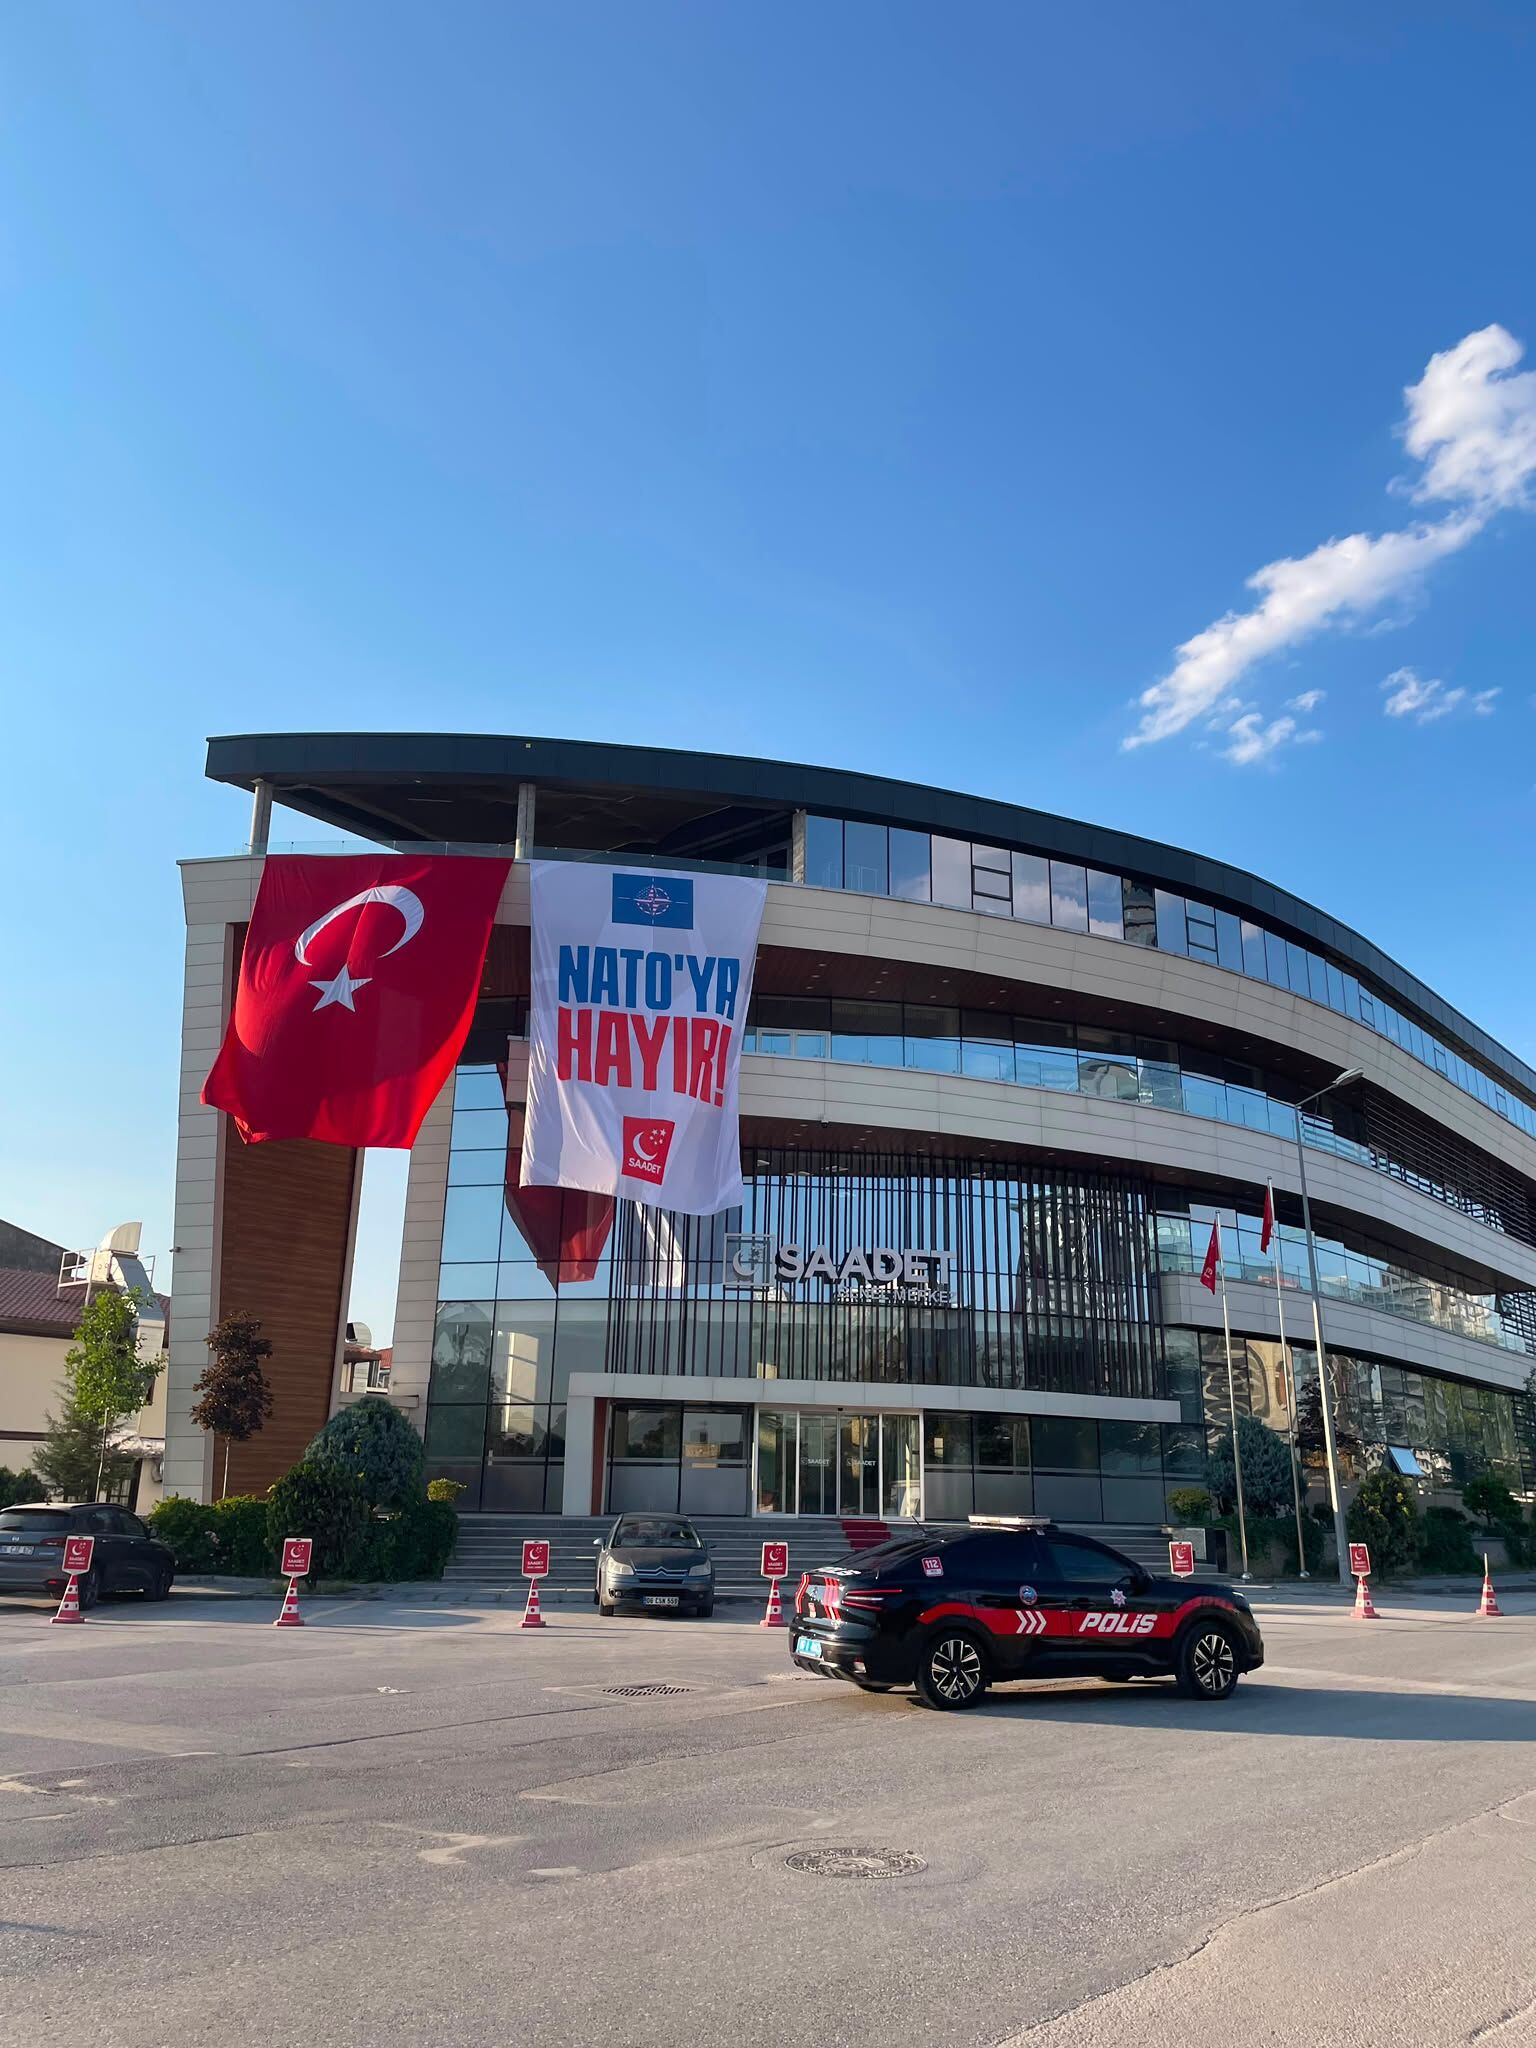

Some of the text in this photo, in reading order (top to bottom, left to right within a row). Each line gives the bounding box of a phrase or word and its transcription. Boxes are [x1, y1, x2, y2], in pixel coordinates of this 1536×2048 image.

[558, 945, 740, 1021] NATO'YA
[557, 1006, 733, 1109] HAYIR!
[628, 1157, 662, 1175] SAADET
[777, 1243, 957, 1284] SAADET
[925, 1559, 939, 1569] 112
